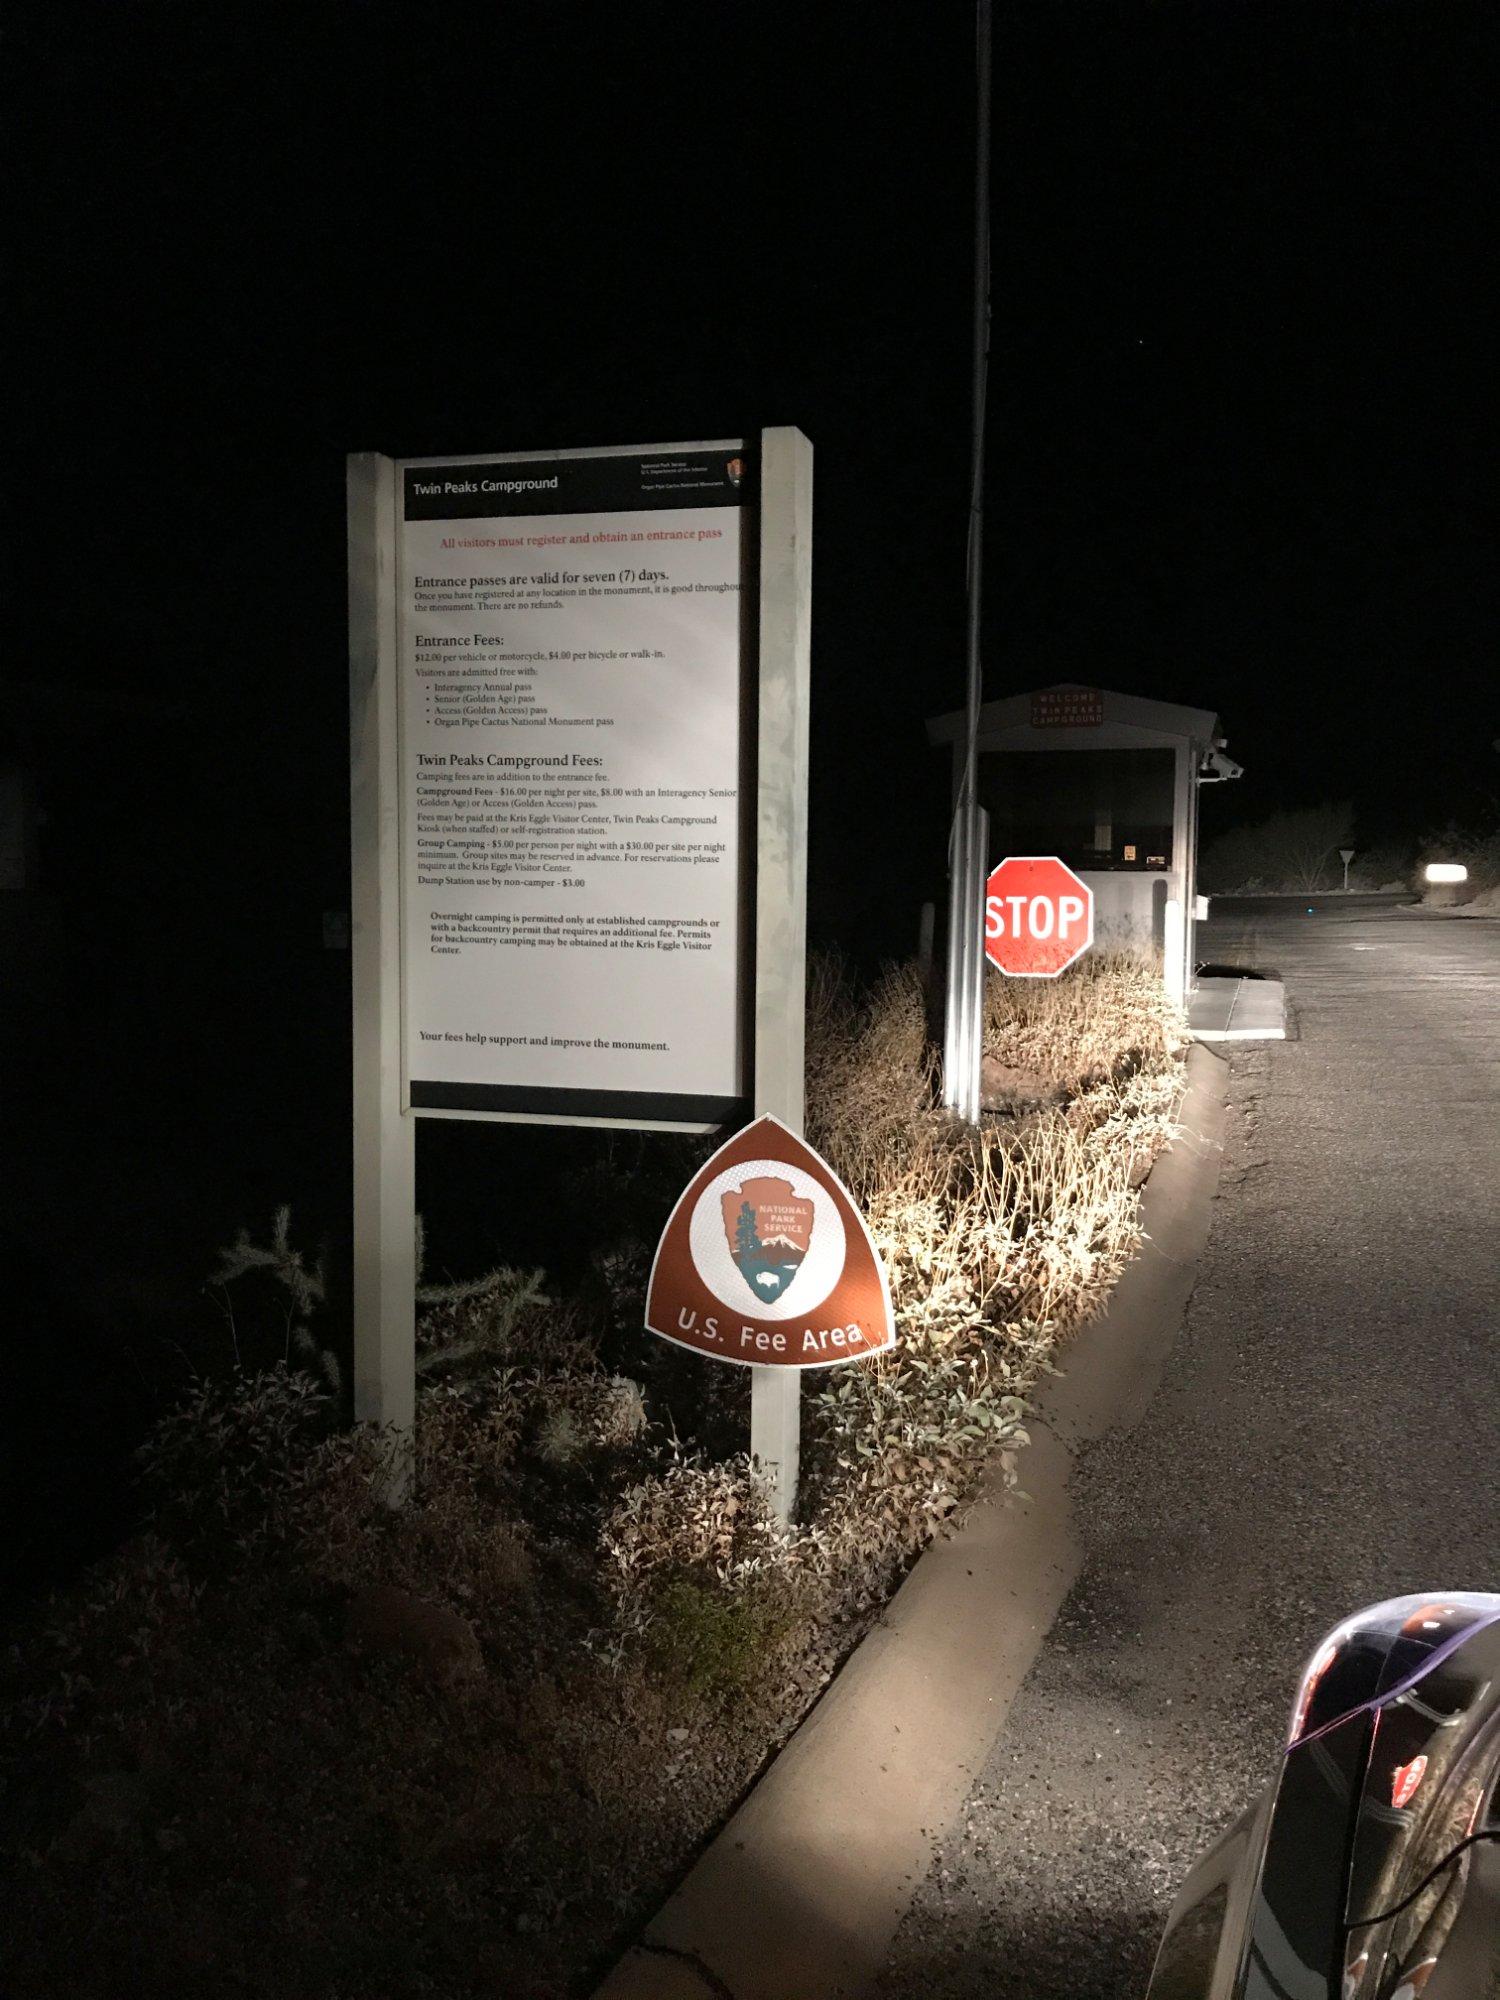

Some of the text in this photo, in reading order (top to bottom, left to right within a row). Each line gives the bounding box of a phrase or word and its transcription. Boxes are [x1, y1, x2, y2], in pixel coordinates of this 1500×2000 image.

[414, 476, 558, 495] Twin Peaks Campground
[441, 529, 722, 549] All visitors must register and obtain an entrance pass
[415, 568, 669, 589] Entrance passes are valid for seven (7) days.
[695, 582, 740, 594] throughou
[415, 633, 504, 647] Entrance Fees:
[417, 754, 603, 768] Twin Peaks Campground Fees:
[416, 771, 453, 782] Camping
[455, 772, 470, 781] fees
[486, 773, 495, 781] in
[496, 772, 531, 781] addition
[532, 773, 541, 781] to
[542, 772, 556, 781] the
[557, 773, 593, 781] entrance
[595, 773, 610, 782] fee.
[417, 786, 473, 798] Campground
[475, 787, 493, 796] Fees
[500, 787, 527, 798] $16.00
[528, 790, 542, 798] per
[544, 787, 565, 798] night
[567, 790, 580, 798] per
[583, 788, 599, 797] site,
[601, 787, 623, 798] $8.00
[625, 788, 643, 797] with
[658, 788, 707, 799] Interagency
[709, 788, 737, 797] Senior
[417, 812, 717, 826] Fees may be paid at the Kris Eggle Visitor Center, Twin Peaks Campground
[417, 838, 445, 849] Group
[447, 839, 485, 850] Camping
[492, 839, 514, 850] $5.00
[516, 842, 529, 850] per
[531, 842, 559, 851] person
[561, 843, 574, 851] per
[576, 841, 597, 851] night
[600, 841, 618, 850] with
[626, 841, 654, 852] $30.00
[655, 844, 669, 852] per
[671, 843, 686, 851] site
[687, 845, 702, 853] per
[704, 842, 726, 853] night
[418, 875, 444, 886] Dump
[445, 876, 475, 885] Station
[492, 877, 502, 887] by
[504, 880, 555, 889] non-camper
[562, 878, 585, 889] $3.00
[430, 911, 473, 923] Overnight
[475, 914, 511, 924] camping
[513, 914, 520, 922] is
[521, 914, 564, 925] permitted
[565, 915, 584, 926] only
[586, 916, 595, 924] at
[596, 916, 646, 925] established
[647, 917, 708, 929] campgrounds
[985, 896, 1083, 939] STOP
[431, 922, 450, 931] with
[458, 923, 511, 935] backcountry
[512, 926, 541, 936] permit
[543, 925, 560, 934] that
[562, 927, 598, 937] requires
[612, 927, 658, 937] additional
[659, 929, 675, 937] fee.
[677, 929, 711, 938] Permits
[431, 934, 443, 942] for
[445, 934, 497, 946] backcountry
[500, 937, 536, 947] camping
[538, 939, 555, 947] may
[557, 937, 568, 946] be
[569, 937, 608, 947] obtained
[620, 939, 634, 948] the
[636, 939, 655, 948] Kris
[657, 940, 681, 951] Eggle
[683, 941, 712, 950] Visitor
[431, 943, 461, 953] Center.
[420, 1031, 669, 1051] Your fees help support and improve the monument.
[760, 1205, 807, 1215] NATIONAL
[771, 1214, 796, 1223] PARK
[764, 1223, 803, 1233] SERVICE
[678, 1307, 863, 1351] U.S. Fee Area
